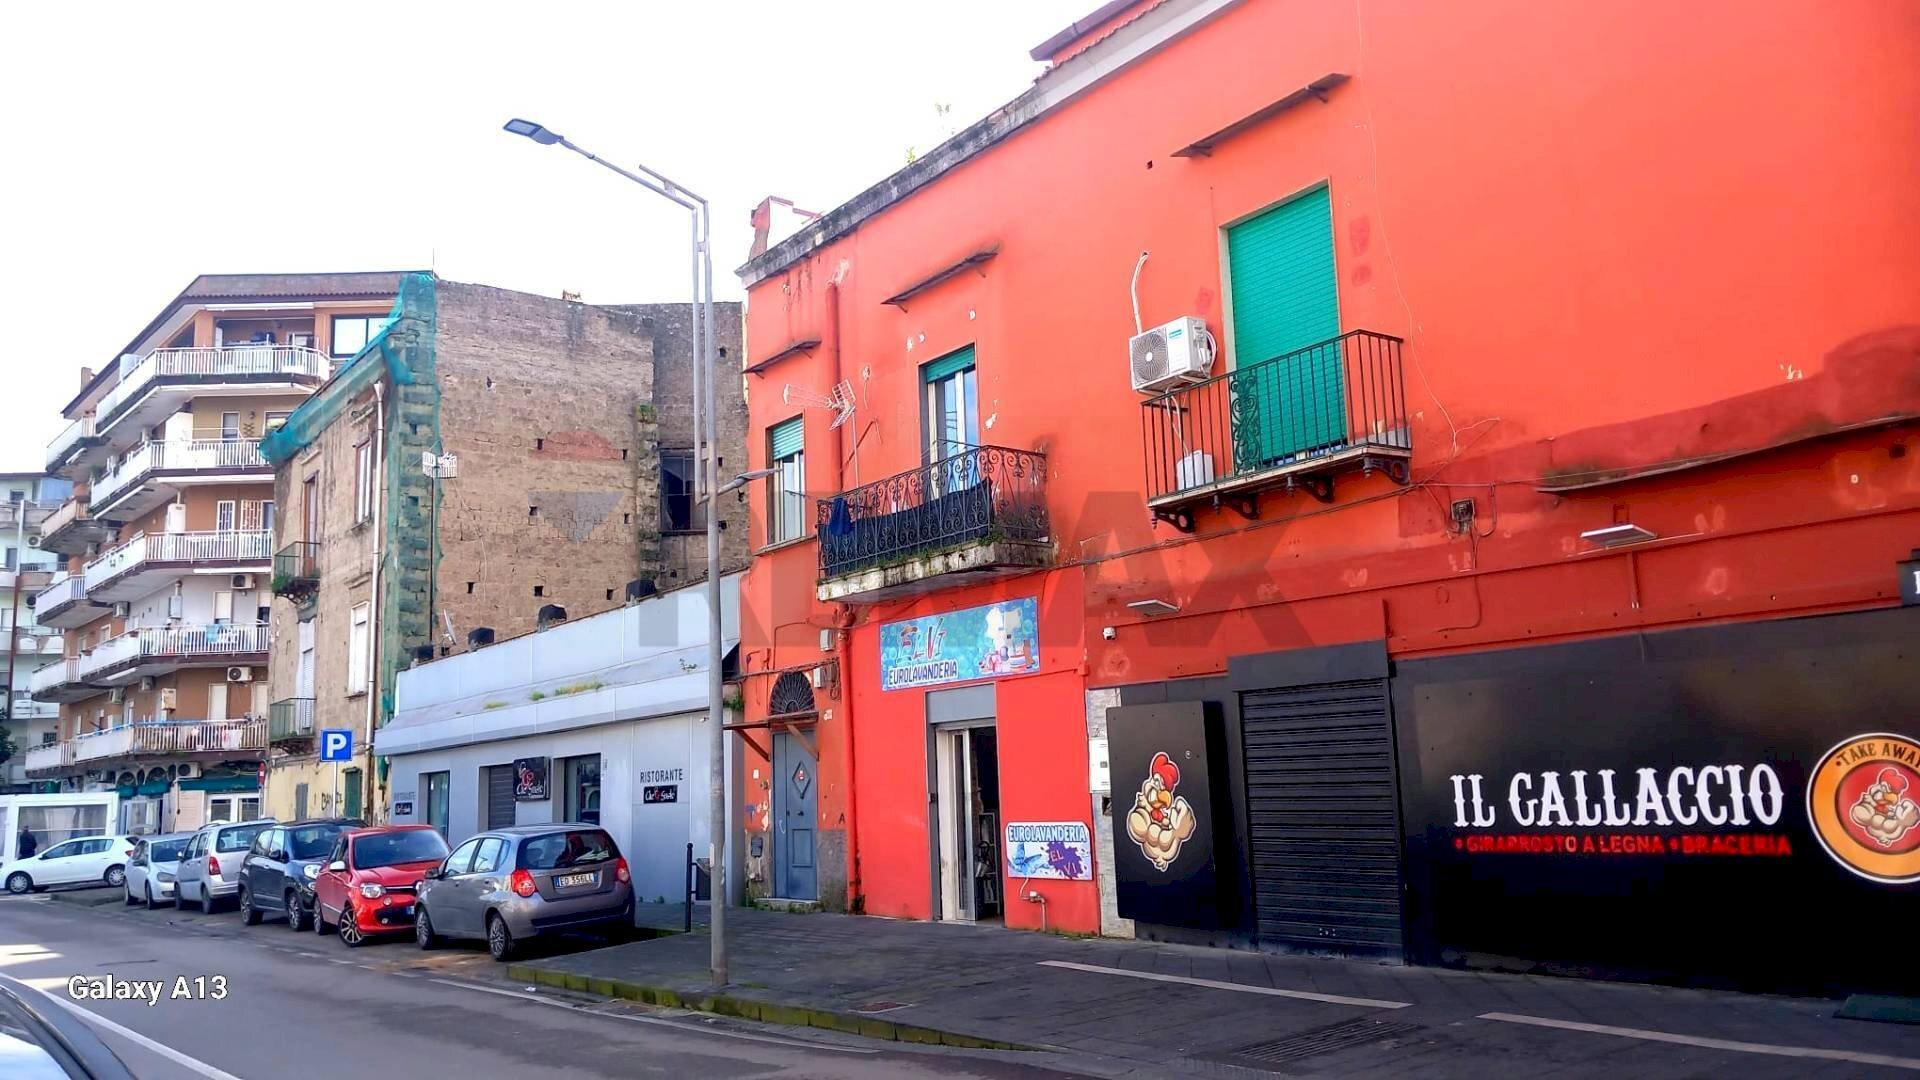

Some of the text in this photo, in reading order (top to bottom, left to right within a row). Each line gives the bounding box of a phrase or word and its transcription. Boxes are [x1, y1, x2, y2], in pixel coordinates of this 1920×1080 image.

[889, 661, 957, 685] EUROLAVANDERIA
[327, 733, 347, 758] P
[1836, 743, 1876, 766] TAKE
[640, 769, 683, 783] RISTORANTE
[1450, 763, 1784, 827] IL GALLACCIO
[1008, 825, 1088, 843] EUROLAVANDERIA
[1050, 850, 1064, 862] EL
[1583, 835, 1596, 854] A
[1600, 835, 1665, 855] LEGNA
[1681, 835, 1793, 857] BRACERIA
[1064, 861, 1077, 875] VI
